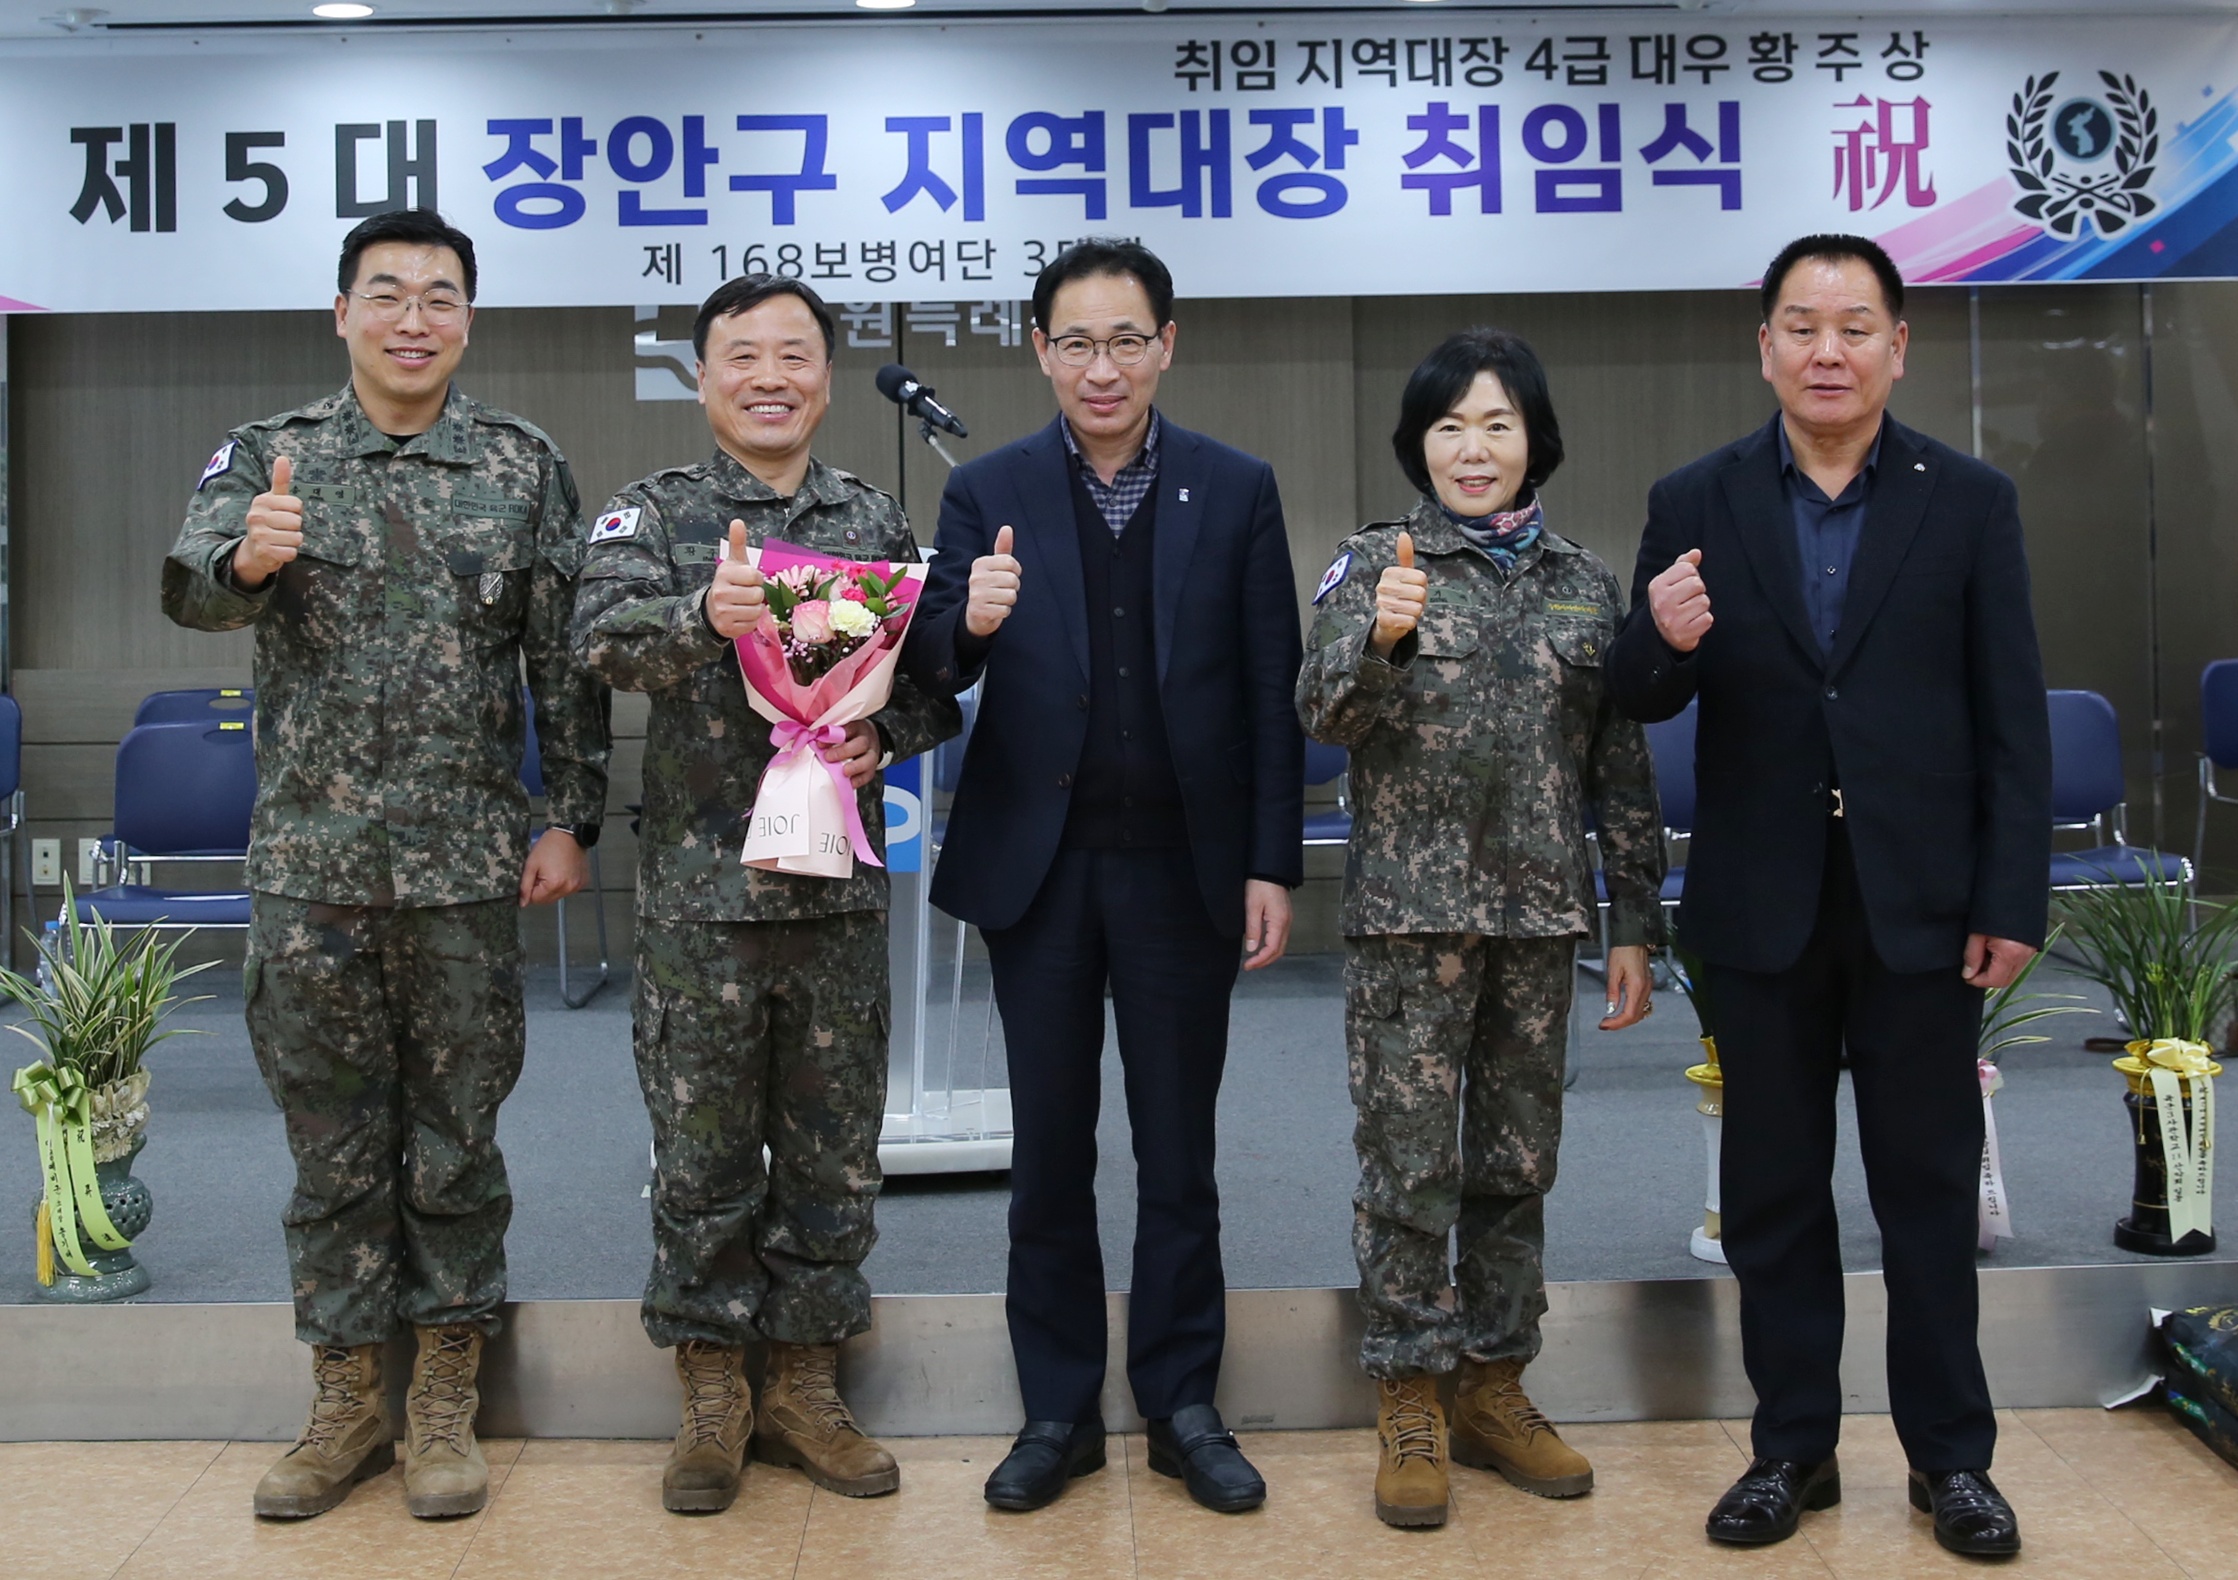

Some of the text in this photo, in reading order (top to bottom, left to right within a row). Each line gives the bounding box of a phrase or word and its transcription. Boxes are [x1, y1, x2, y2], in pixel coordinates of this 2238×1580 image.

[1174, 39, 1277, 92] 취임
[1296, 35, 1510, 90] 지역대장
[1525, 35, 1609, 86] 4급
[1630, 34, 1731, 85] 대우
[69, 94, 1938, 233] 제 5 대 장안구 지역대장 취임식 祝
[642, 242, 682, 285] 제
[711, 239, 997, 283] 168보병여단
[840, 302, 1036, 347] 원특례
[759, 813, 801, 837] JOIE
